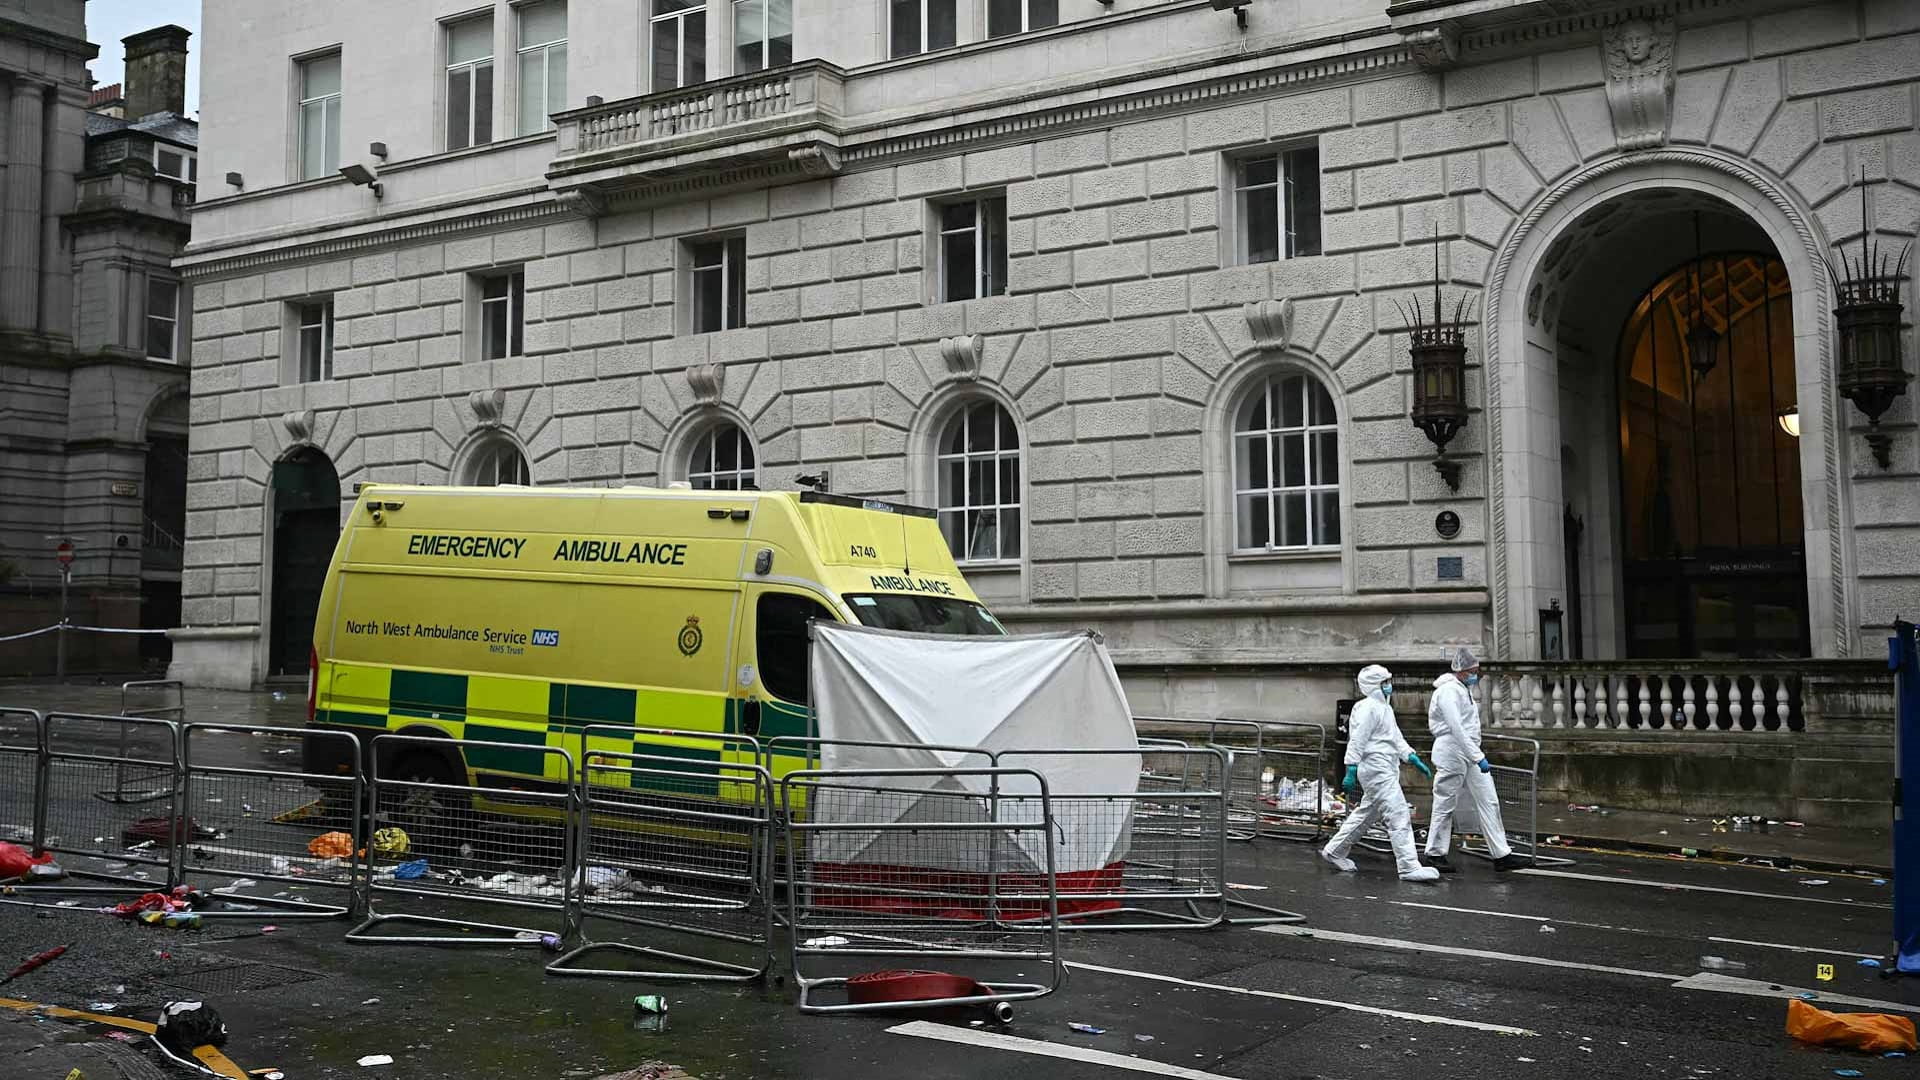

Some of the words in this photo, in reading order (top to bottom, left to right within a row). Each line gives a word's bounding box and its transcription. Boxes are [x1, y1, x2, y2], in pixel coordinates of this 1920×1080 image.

[407, 534, 527, 559] EMERGENCY
[553, 539, 688, 566] AMBULANCE
[851, 545, 876, 558] A740
[870, 575, 956, 596] AMBULANCE
[346, 620, 379, 635] North
[383, 621, 411, 637] West
[414, 623, 479, 641] Ambulance
[483, 628, 527, 645] Service
[532, 629, 559, 646] NHS
[490, 644, 505, 655] NHS
[507, 645, 525, 655] Trust
[1819, 966, 1831, 976] 14
